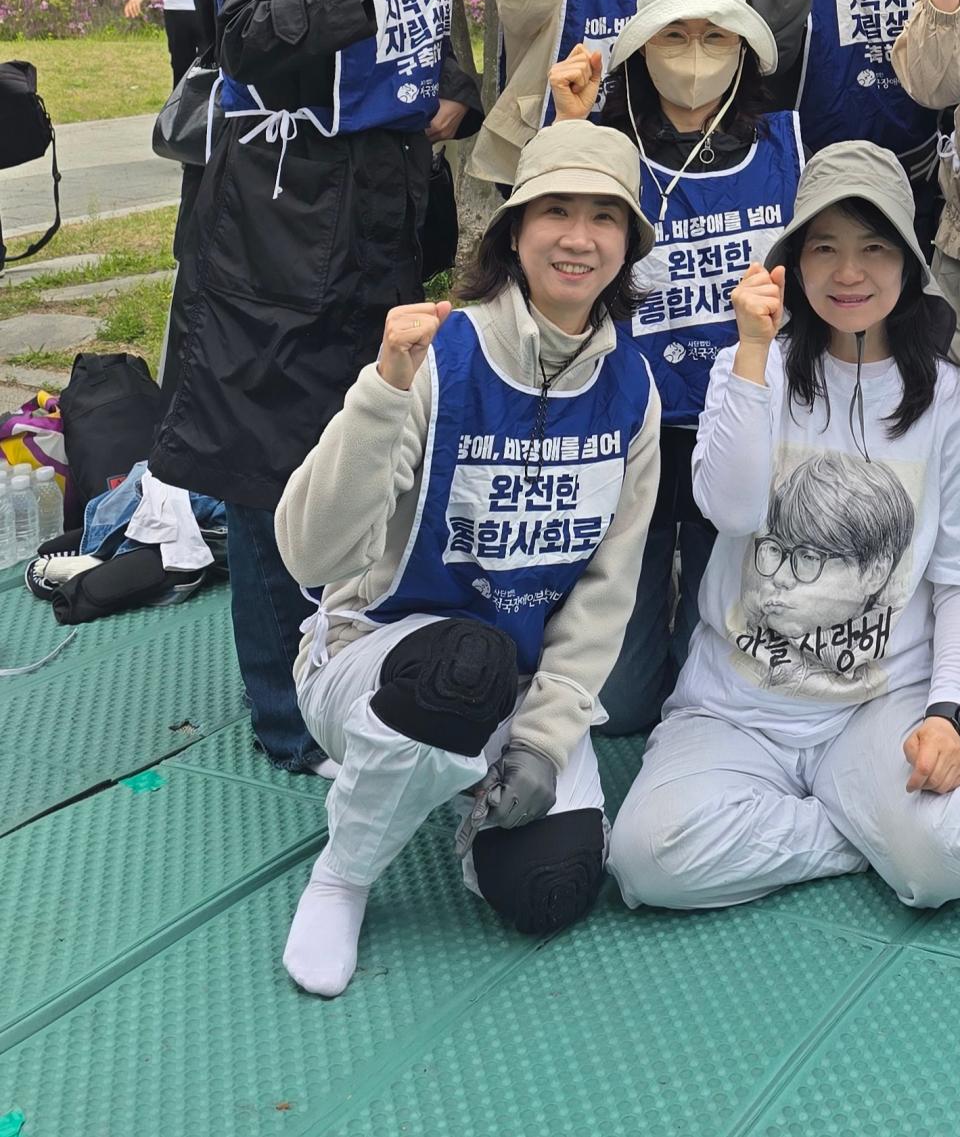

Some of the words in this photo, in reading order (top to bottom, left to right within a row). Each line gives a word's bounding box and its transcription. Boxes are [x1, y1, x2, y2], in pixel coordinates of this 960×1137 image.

[671, 210, 742, 239] 비장애를
[746, 204, 783, 227] 넘어
[668, 239, 753, 281] 완전한
[503, 436, 580, 461] 비장애를
[488, 473, 579, 512] 완전한
[799, 606, 892, 672] 사랑해
